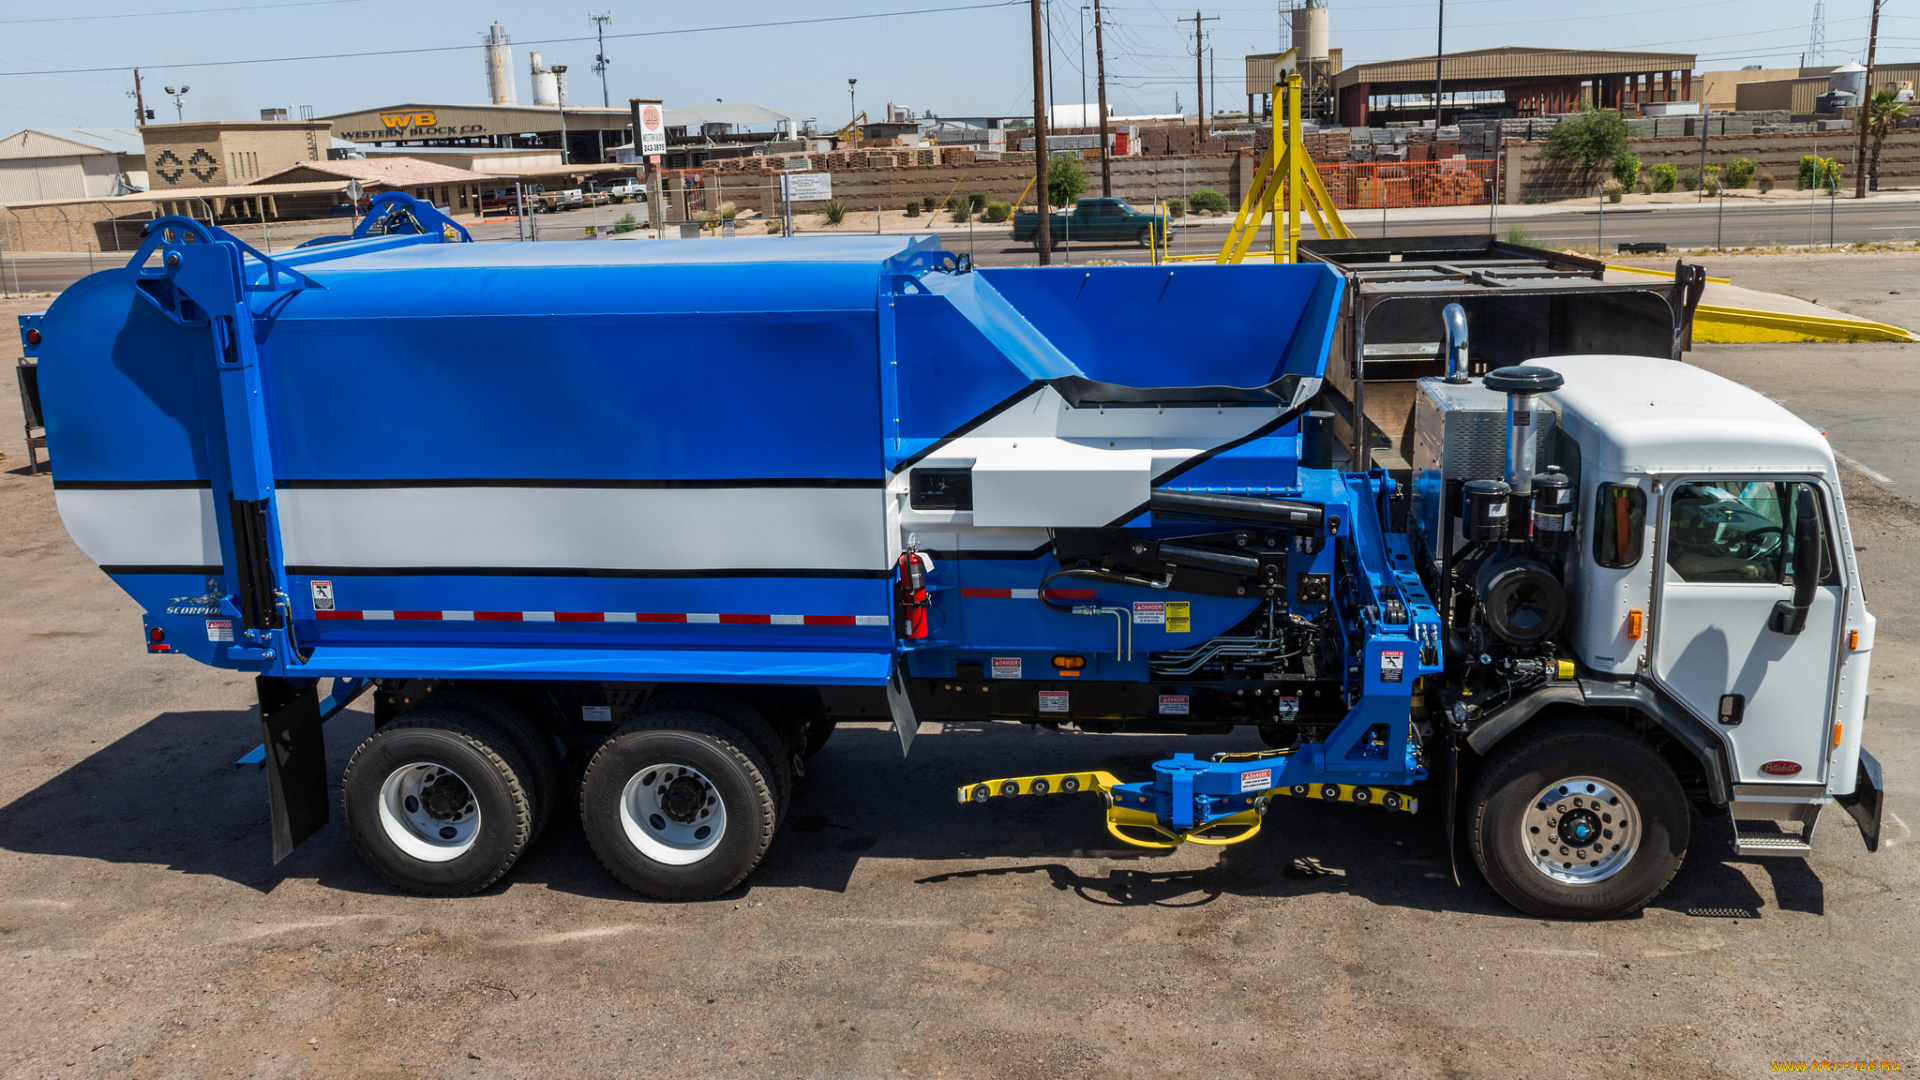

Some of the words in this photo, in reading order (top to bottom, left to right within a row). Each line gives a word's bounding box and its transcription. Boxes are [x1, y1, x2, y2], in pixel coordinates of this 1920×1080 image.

[381, 113, 438, 128] WB
[341, 127, 404, 139] WESTERN
[410, 125, 457, 136] BLOCK
[460, 124, 487, 134] CO.
[644, 144, 665, 152] 243-3975
